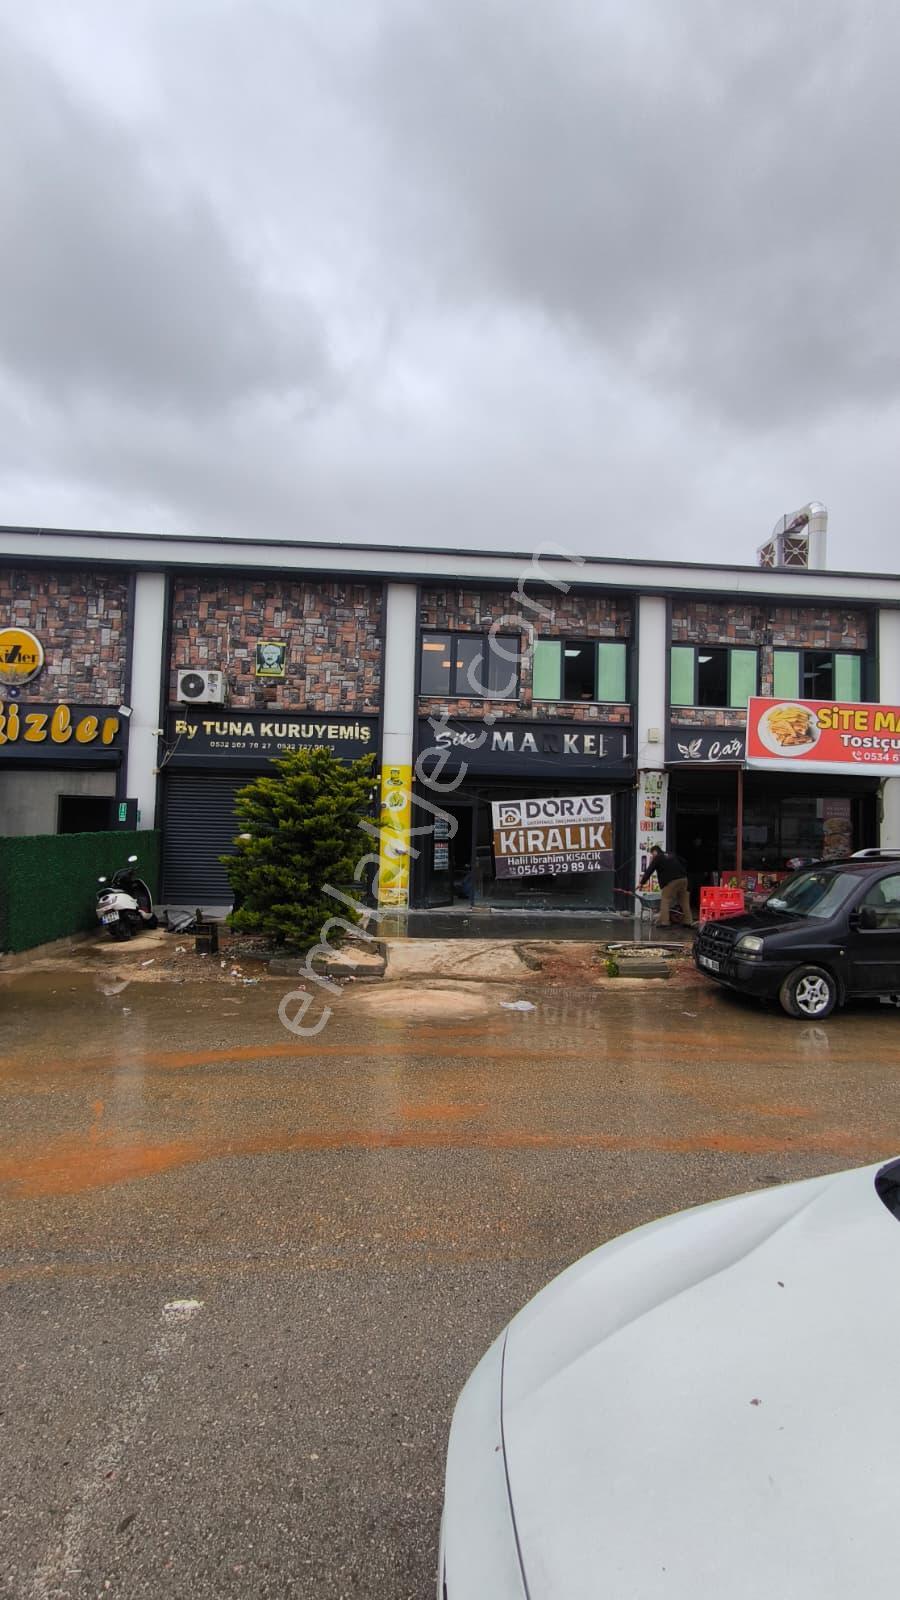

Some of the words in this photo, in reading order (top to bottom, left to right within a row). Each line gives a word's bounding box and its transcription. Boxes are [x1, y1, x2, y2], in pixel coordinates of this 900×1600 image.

[874, 711, 900, 732] M
[175, 720, 198, 739] By
[203, 721, 255, 737] TUNA
[260, 722, 371, 744] KURUYEMİŞ
[435, 731, 477, 749] Site
[863, 752, 889, 761] 0534
[892, 754, 900, 762] 6
[525, 798, 604, 818] DORAS
[507, 856, 529, 866] Halil
[517, 863, 545, 875] 0545
[548, 862, 569, 873] 329
[571, 861, 585, 871] 89
[587, 860, 601, 870] 44
